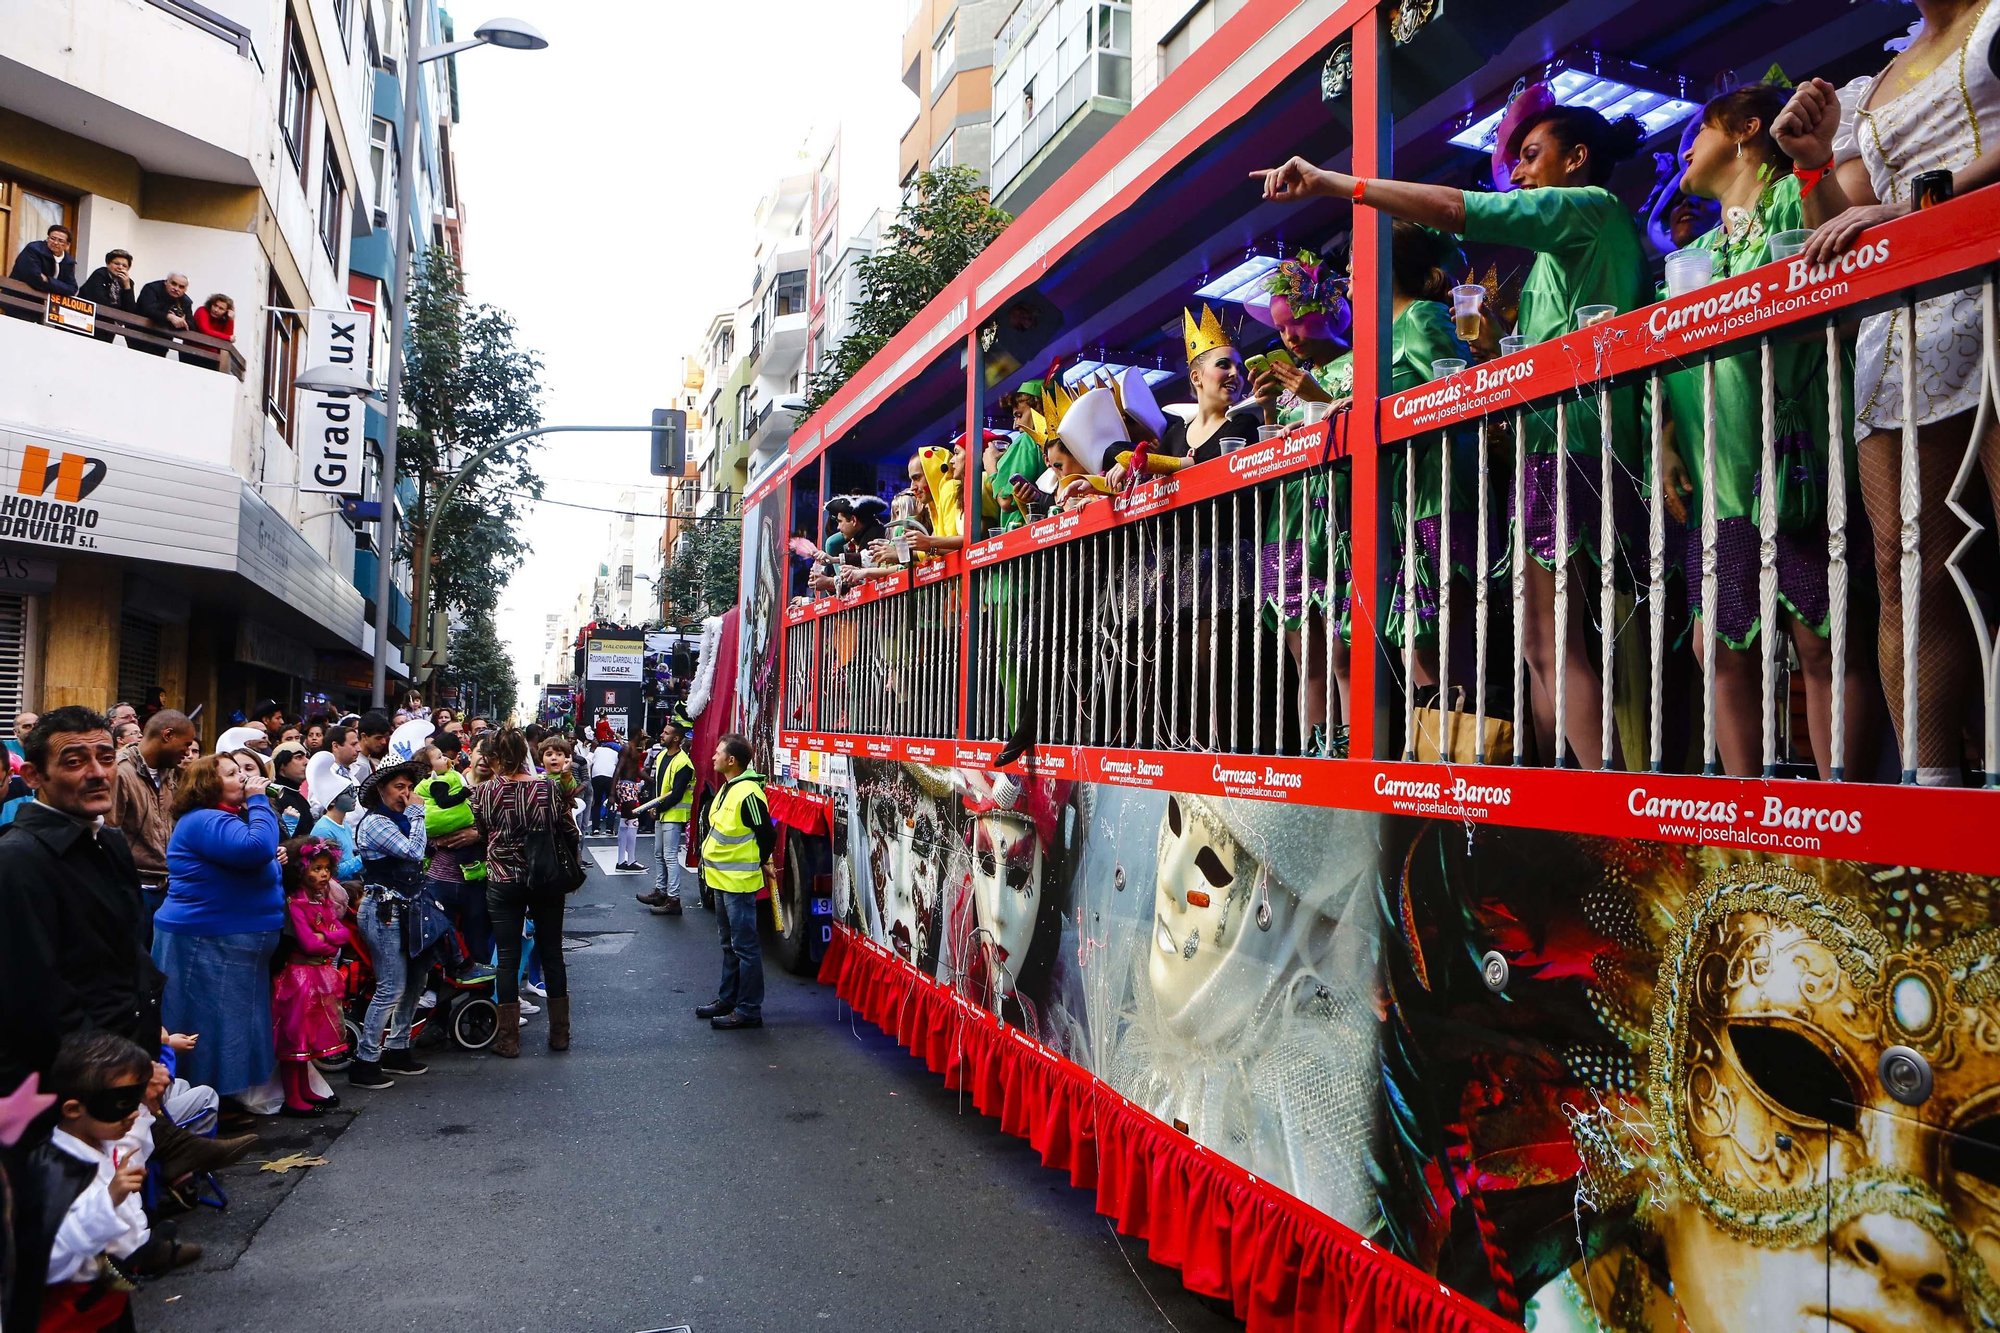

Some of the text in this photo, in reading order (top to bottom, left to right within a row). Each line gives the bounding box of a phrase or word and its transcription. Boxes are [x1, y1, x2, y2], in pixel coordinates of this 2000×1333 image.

[1649, 281, 1762, 336] Carrozas
[1785, 238, 1890, 294] Barcos
[50, 293, 93, 314] SE ALQUILA
[1681, 281, 1849, 344] www.josehalcon.com
[314, 322, 356, 487] Gradux
[1393, 382, 1462, 419] Carrozas
[1475, 358, 1534, 394] Barcos
[1412, 388, 1511, 426] www.josehalcon.com
[1229, 446, 1275, 473] Carrozas
[1283, 431, 1321, 456] Barcos
[1242, 453, 1307, 480] www.josehalcon.com
[1114, 491, 1147, 511] Caozas
[1152, 479, 1180, 499] Barcos
[0, 516, 97, 548] DAVILA S.L.
[1045, 752, 1065, 768] Barcos
[1100, 756, 1132, 775] Carrozas
[1137, 759, 1164, 777] Barcos
[1212, 763, 1257, 785] Carrozas
[1264, 766, 1302, 788] Barcos
[1225, 784, 1287, 799] www.josehalcon.com
[1374, 772, 1441, 799] Carrozas
[1453, 777, 1511, 805] Barcos
[1392, 799, 1488, 818] www.josehalcon.com
[1627, 788, 1738, 824] Carrozas
[1760, 796, 1862, 834] Barcos
[1658, 823, 1821, 850] www.josehalcon.com
